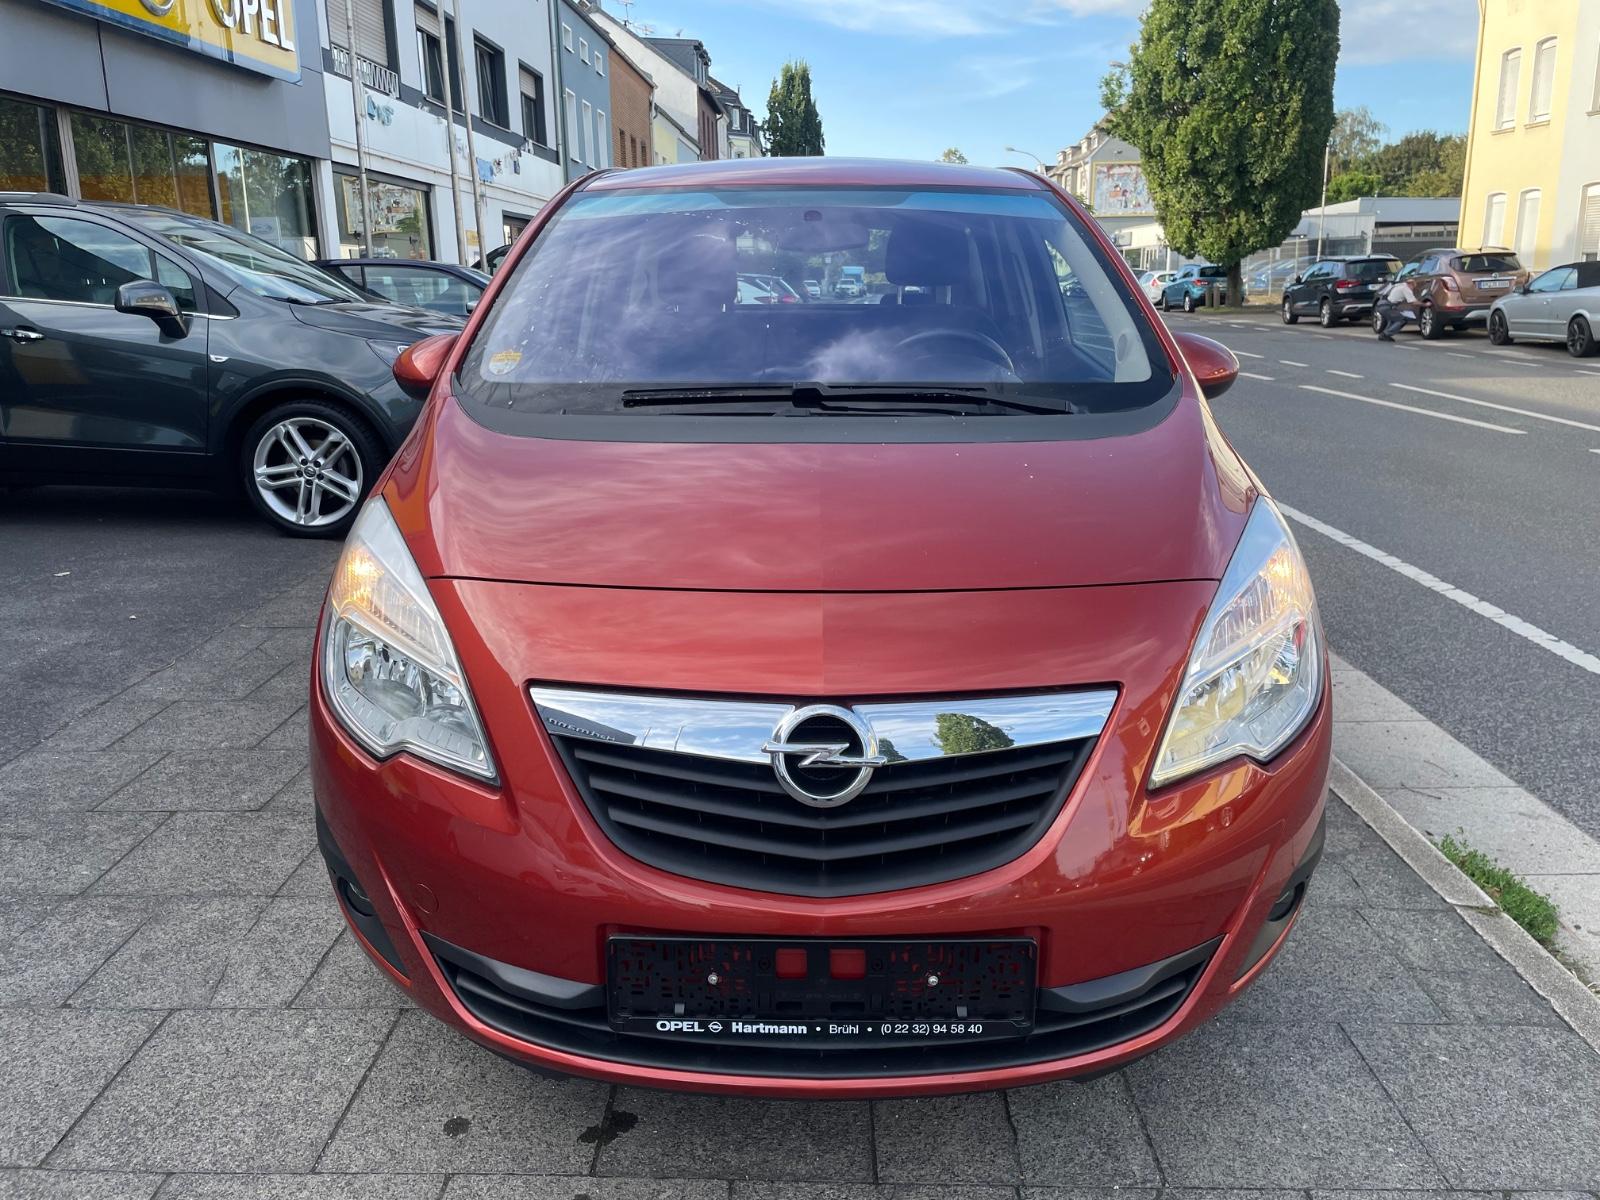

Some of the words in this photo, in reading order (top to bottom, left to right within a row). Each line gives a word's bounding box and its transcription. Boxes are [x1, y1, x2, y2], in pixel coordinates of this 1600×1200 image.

[656, 1020, 705, 1032] OPEL
[731, 1021, 808, 1034] Hartmann
[829, 1024, 859, 1035] Brühl
[880, 1023, 892, 1036] (0
[894, 1024, 909, 1034] 22
[911, 1023, 930, 1036] 32)
[932, 1024, 948, 1034] 94
[950, 1024, 965, 1034] 58
[967, 1024, 983, 1034] 40
